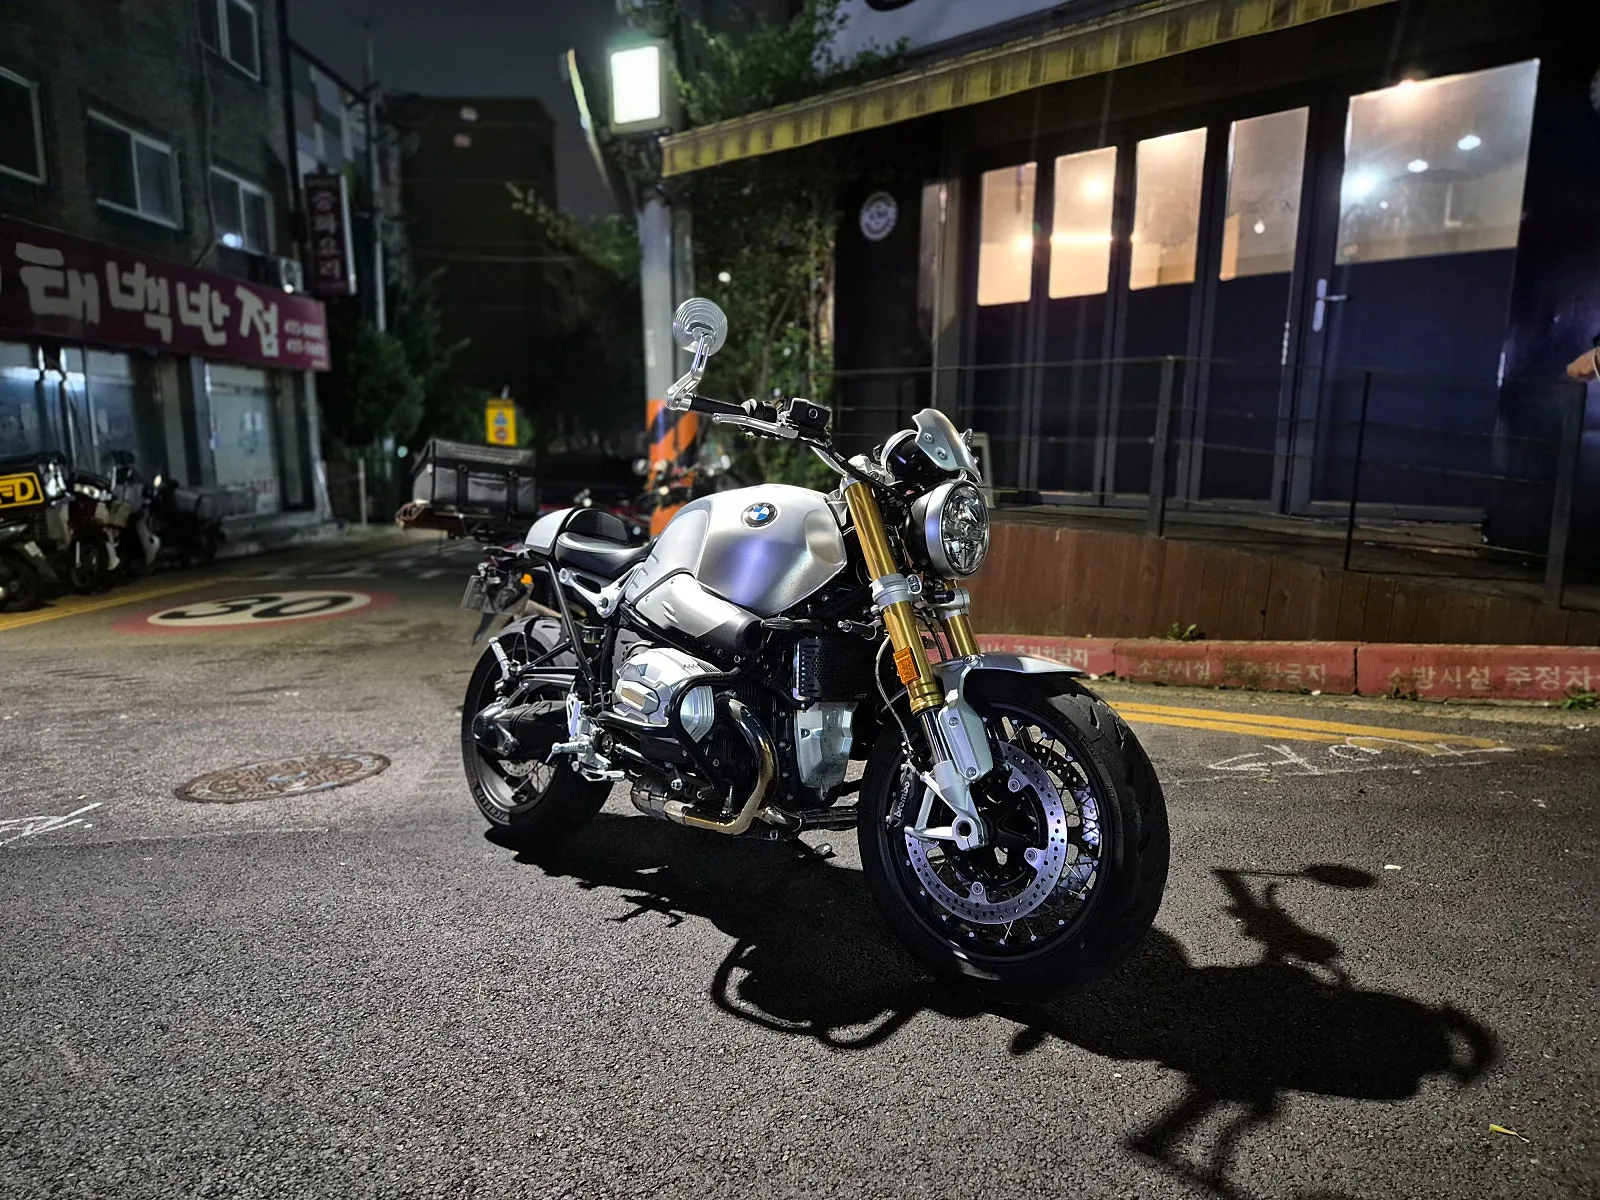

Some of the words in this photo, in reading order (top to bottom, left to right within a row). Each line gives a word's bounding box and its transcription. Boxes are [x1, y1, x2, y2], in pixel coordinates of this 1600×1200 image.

[15, 241, 280, 358] 태백반점
[159, 595, 354, 620] 30
[1387, 665, 1491, 690] 소방시설
[1506, 665, 1600, 691] 주정차
[894, 781, 911, 818] brembo
